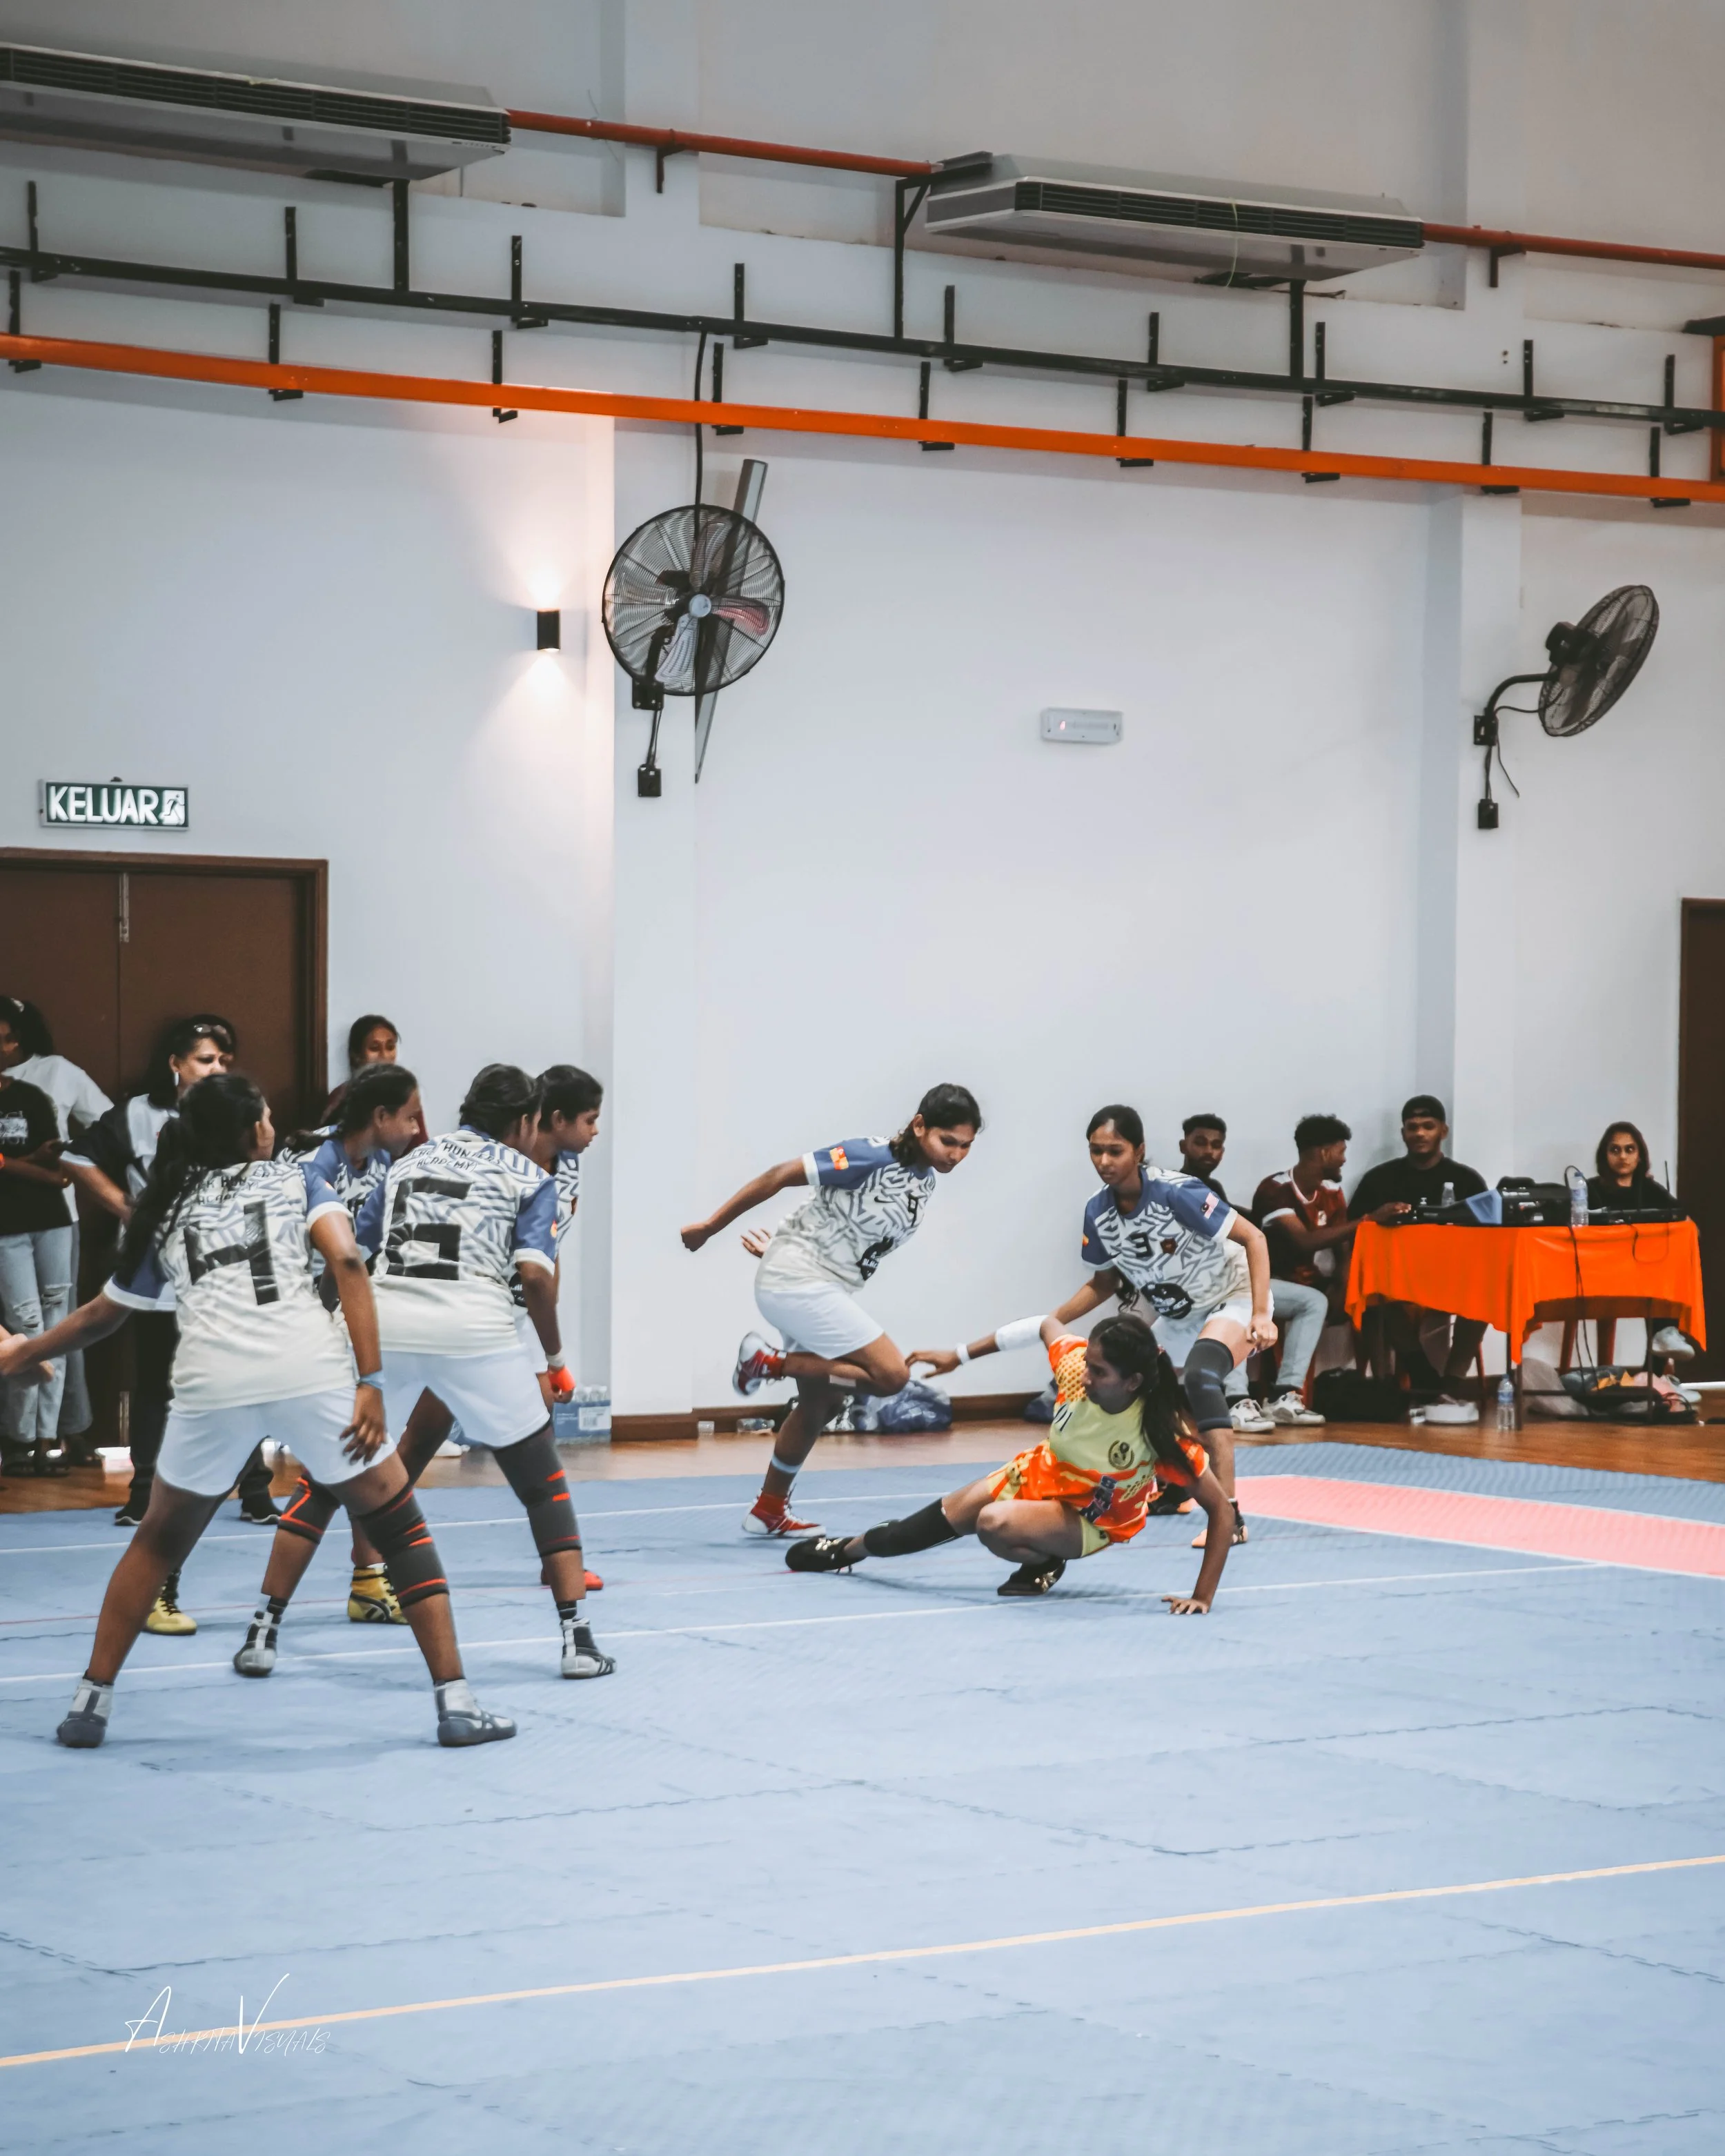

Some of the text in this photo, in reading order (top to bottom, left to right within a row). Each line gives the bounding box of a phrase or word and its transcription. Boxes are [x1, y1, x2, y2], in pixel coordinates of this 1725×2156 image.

[49, 785, 159, 824] KELUAR
[184, 1200, 280, 1305] 4
[385, 1175, 473, 1281] 6
[1129, 1232, 1155, 1258] 3
